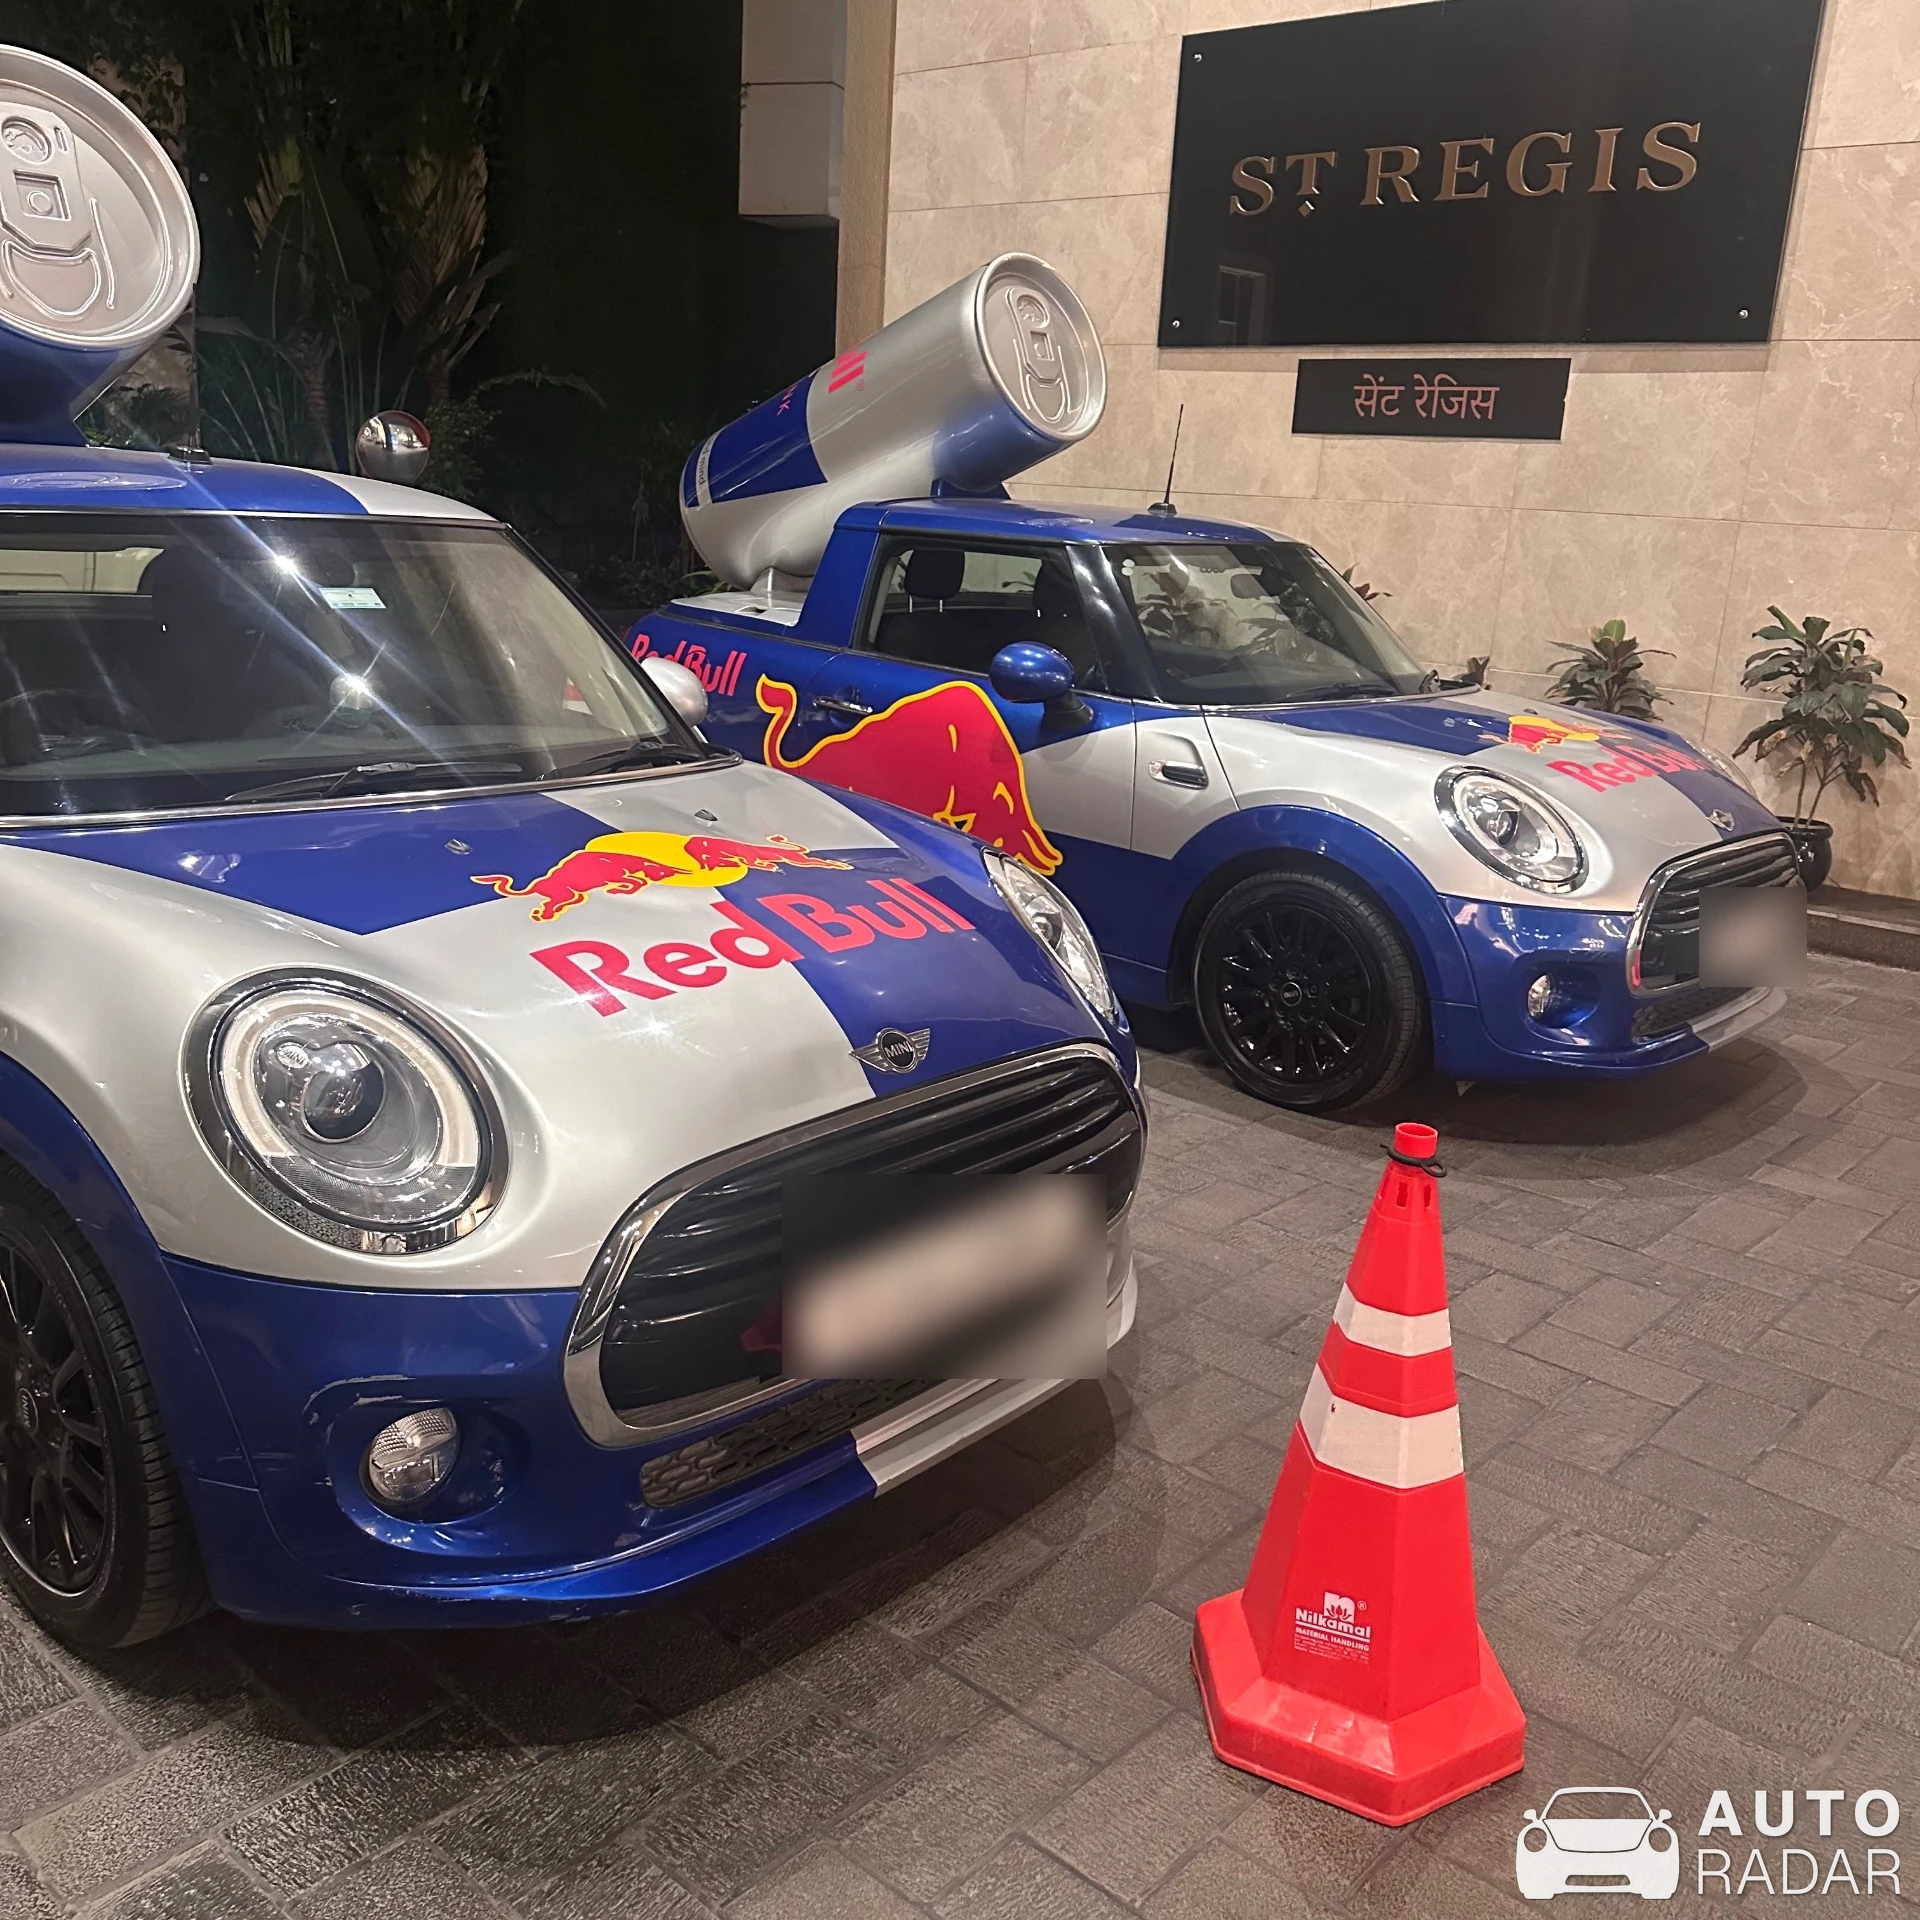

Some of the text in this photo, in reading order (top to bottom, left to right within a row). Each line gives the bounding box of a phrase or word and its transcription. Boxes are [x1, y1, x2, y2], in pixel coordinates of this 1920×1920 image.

[1360, 122, 1701, 205] REGIS
[1353, 373, 1500, 420] सेंट रेजिस
[1545, 744, 1660, 793] Red
[529, 877, 977, 1018] Red Bull
[884, 1040, 914, 1058] MINI
[1296, 1608, 1370, 1638] Nilkamal
[1296, 1627, 1329, 1642] MATERIAL
[1331, 1636, 1370, 1651] HANDLING
